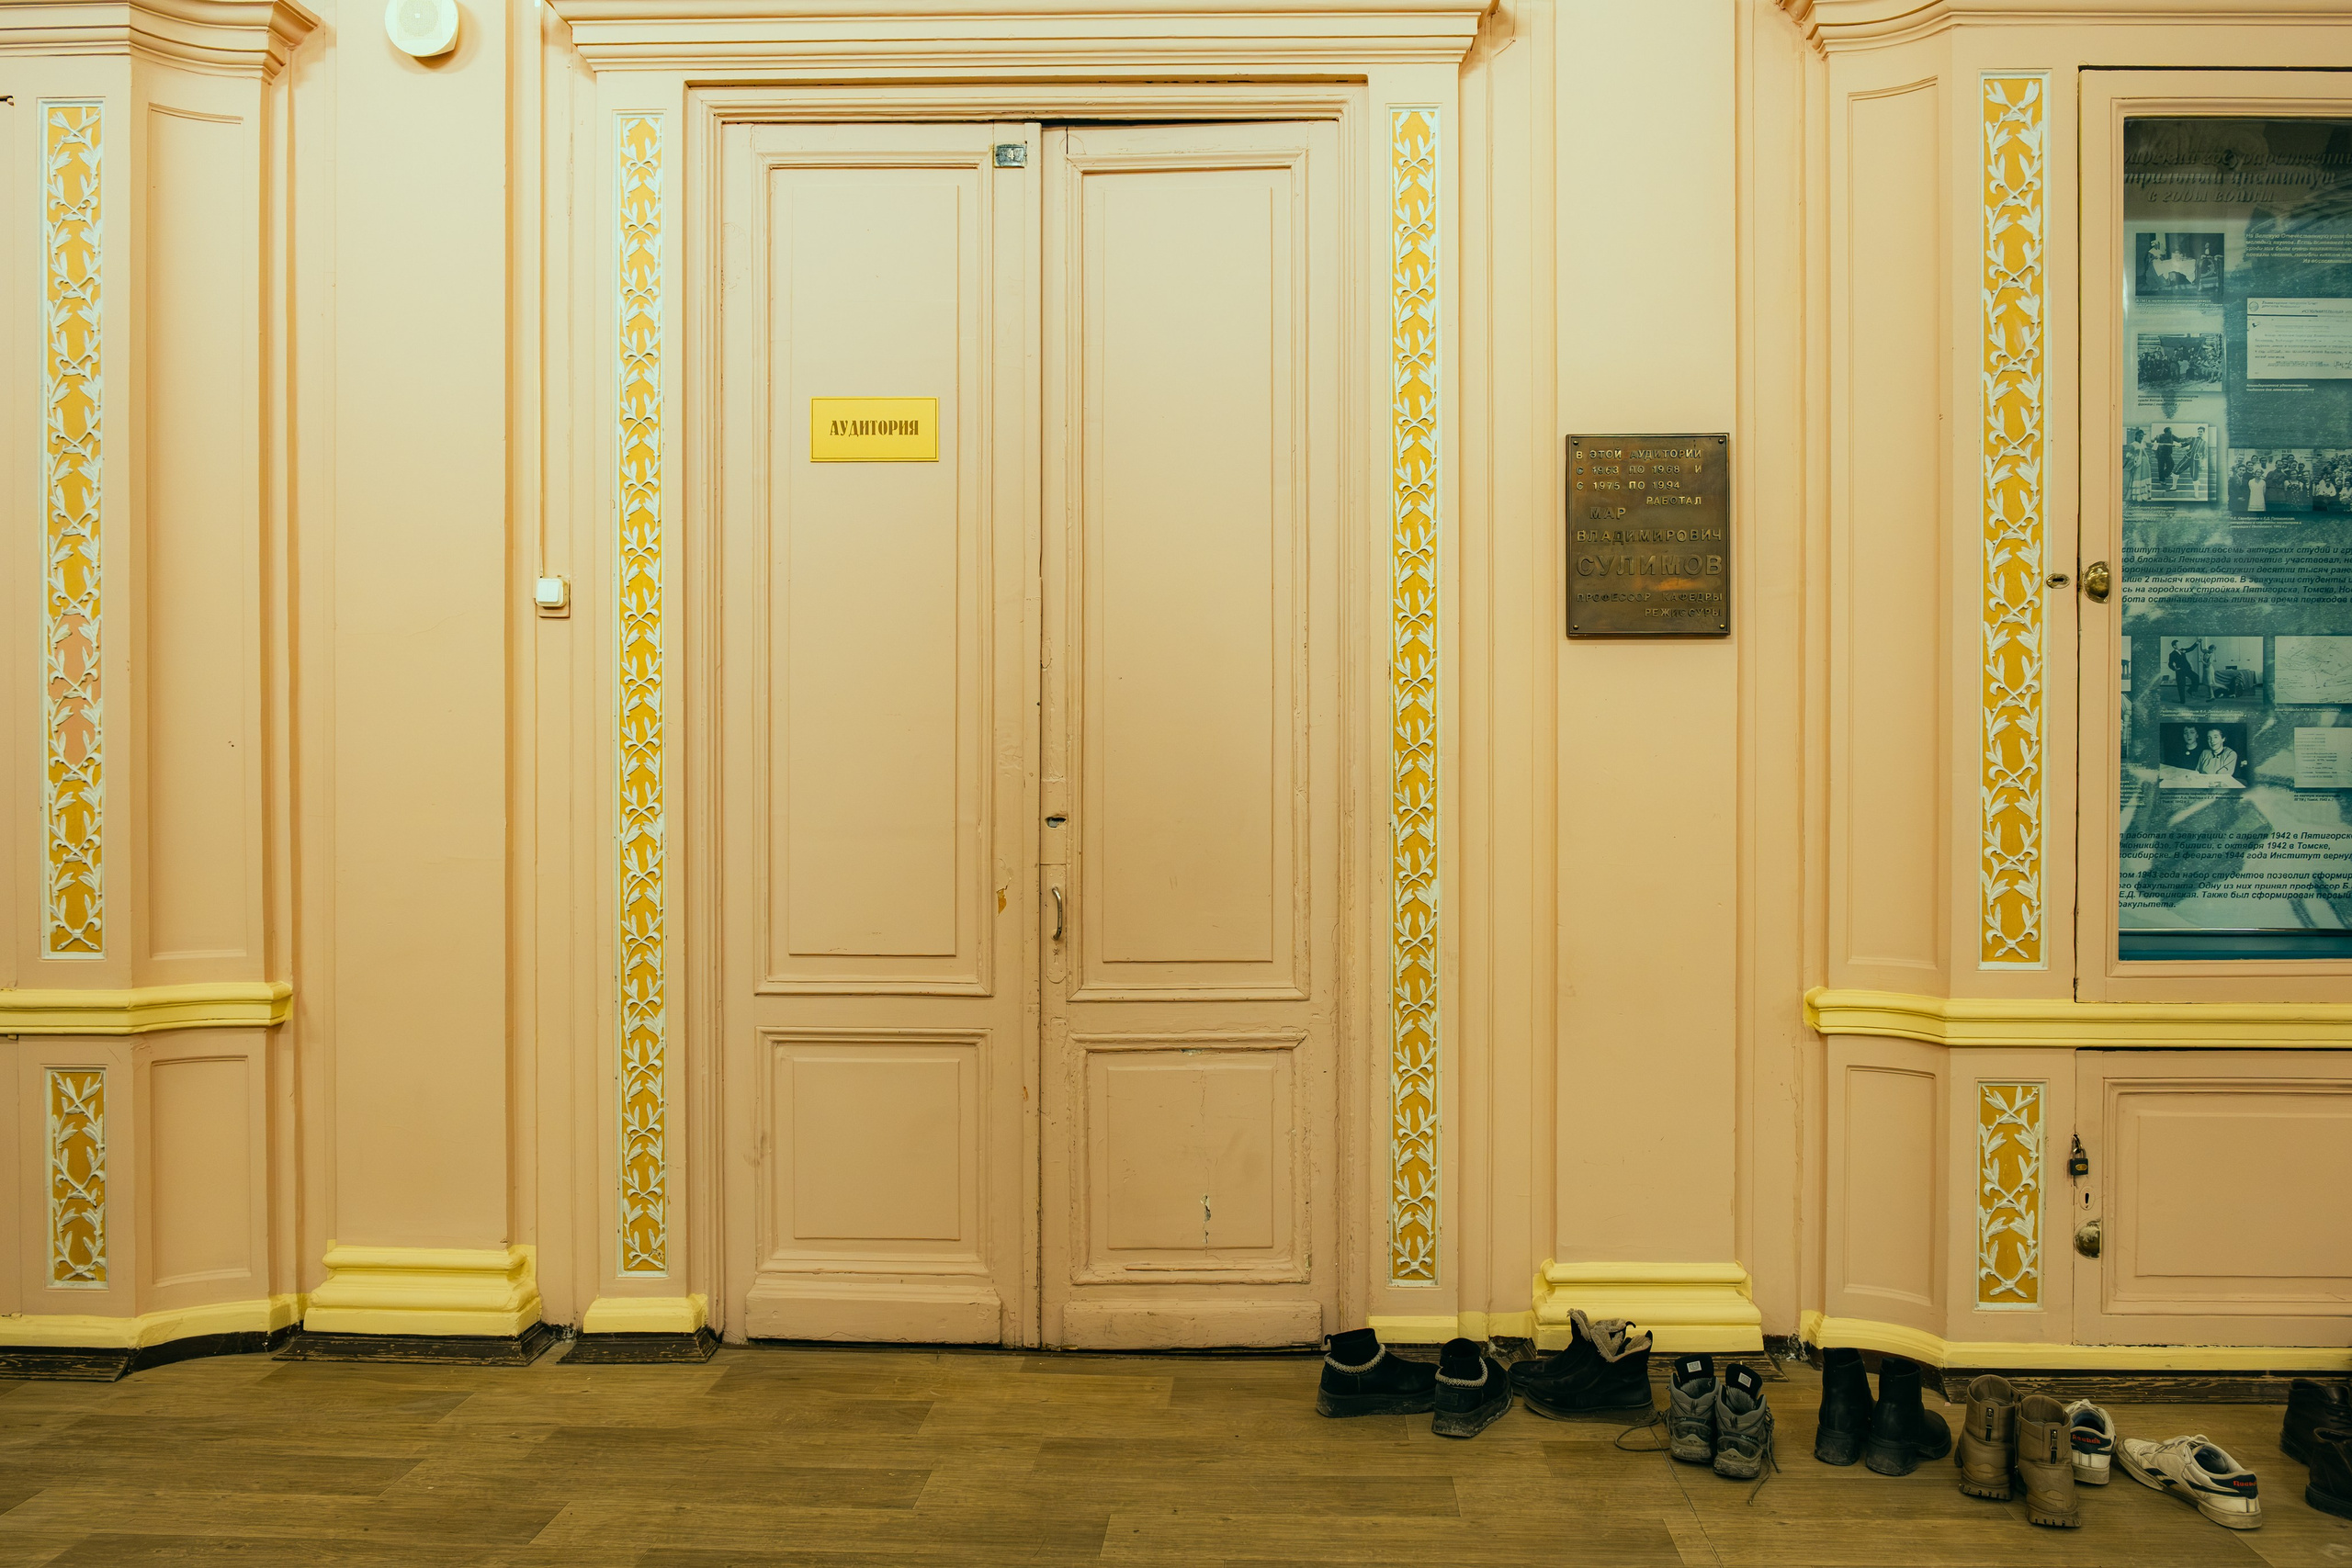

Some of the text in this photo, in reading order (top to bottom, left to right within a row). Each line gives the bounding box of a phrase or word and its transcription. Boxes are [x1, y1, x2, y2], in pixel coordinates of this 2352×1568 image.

[2163, 190, 2208, 203] годы
[2212, 190, 2274, 203] войны
[830, 420, 920, 437] АУДИТОРИЯ
[1576, 448, 1702, 460] В ЭТОЙ АУДИТОРИИ
[1577, 466, 1702, 475] С 1963 ПО 1968 И
[1577, 481, 1680, 490] С 1975 ПО 1994
[1646, 497, 1702, 506] РАБОТАЛ
[1589, 507, 1626, 520] МАР
[1577, 529, 1722, 545] ВЛАДИМИРОВИЧ
[2162, 547, 2210, 555] выпустил
[2211, 547, 2245, 555] восемь
[2246, 547, 2294, 555] актерских
[2296, 547, 2331, 555] студий
[2137, 556, 2176, 564] блокады
[2177, 556, 2231, 564] Ленинграда
[2233, 556, 2283, 564] коллектив
[1576, 554, 1723, 576] СУЛИМОВ
[2165, 566, 2208, 574] работах,
[2210, 566, 2254, 574] обслужил
[2256, 566, 2295, 574] десятки
[2297, 566, 2328, 574] тысяч
[2185, 576, 2237, 584] концертов.
[2248, 576, 2295, 584] эвакуации
[2297, 576, 2346, 584] студенты
[1577, 592, 1723, 603] ПРОФЕССОР КАФЕДРЫ
[2301, 595, 2347, 604] переходов
[1645, 608, 1722, 617] РЕЖИССУРЫ
[2126, 831, 2165, 840] работал
[2174, 841, 2215, 850] Тбилиси,
[2224, 841, 2264, 850] октября
[2267, 841, 2288, 850] 1942
[2297, 841, 2331, 850] Томске,
[2174, 852, 2180, 860] В
[2182, 852, 2222, 860] феврале
[2225, 852, 2245, 860] 1944
[2246, 852, 2267, 860] года
[2269, 852, 2321, 861] Институт
[2138, 872, 2157, 880] 1943
[2159, 872, 2180, 880] года
[2182, 872, 2210, 880] набор
[2211, 872, 2264, 880] студентов
[2267, 872, 2310, 880] позволил
[2138, 891, 2199, 899] Головинская.
[2202, 891, 2228, 899] Также
[2230, 891, 2249, 899] был
[2251, 891, 2314, 899] сформирован
[2316, 891, 2351, 899] первый
